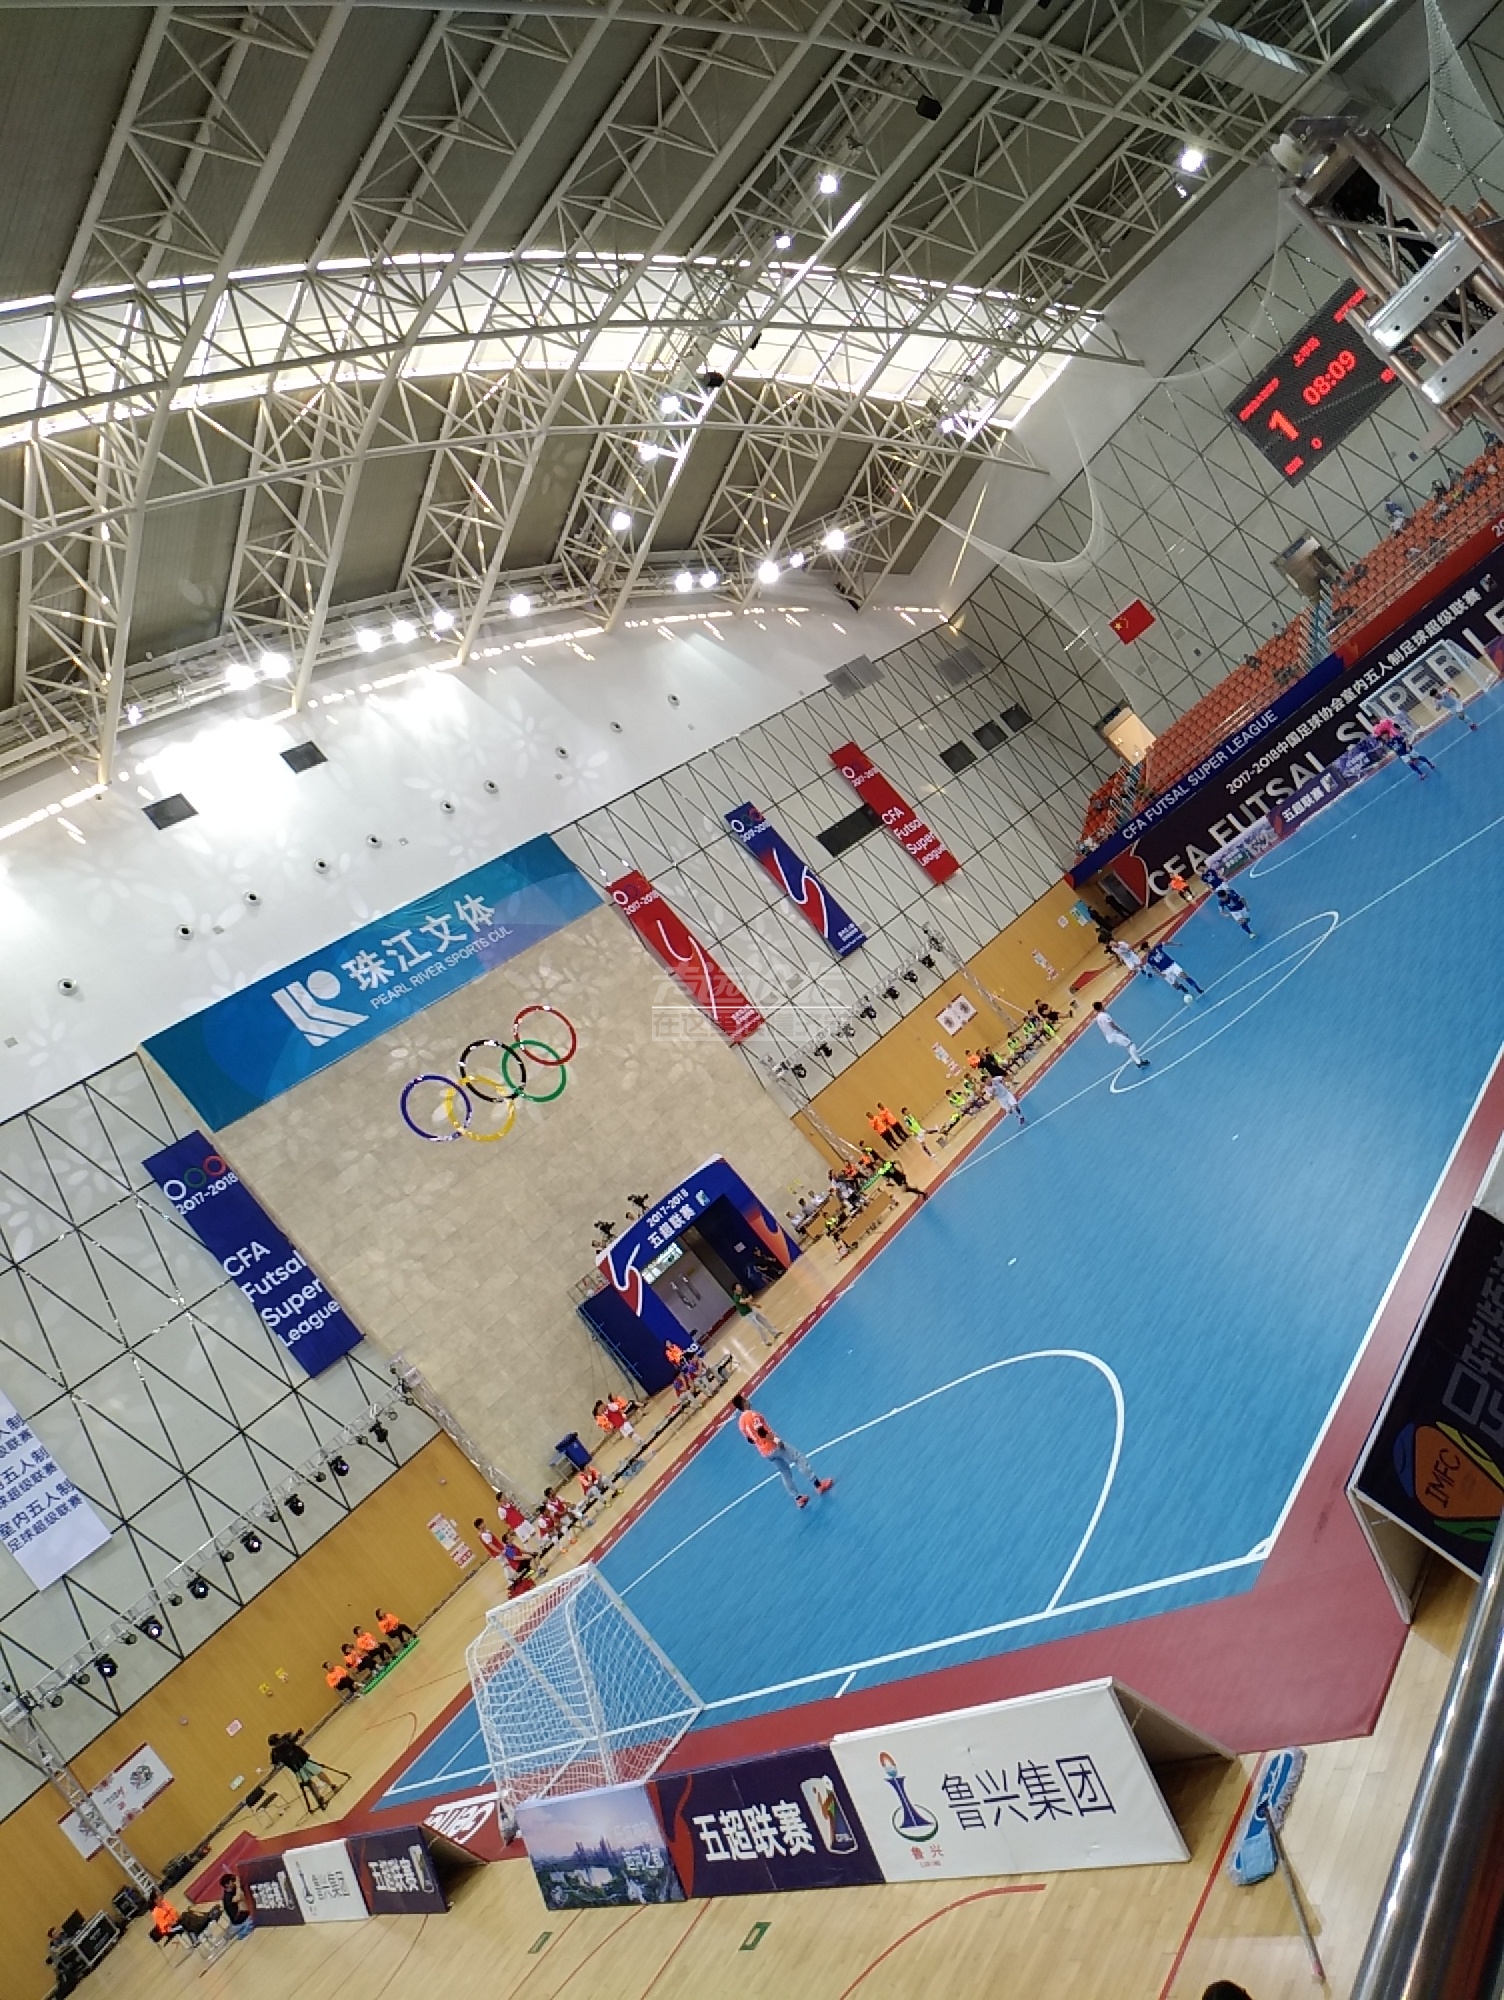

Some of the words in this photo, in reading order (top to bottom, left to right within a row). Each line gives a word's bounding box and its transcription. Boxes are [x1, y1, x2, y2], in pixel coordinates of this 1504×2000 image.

[1303, 350, 1356, 406] 08:09
[1122, 815, 1146, 840] CFA
[1145, 786, 1190, 823] FUTSAL
[1188, 750, 1227, 788] SUPER
[1227, 708, 1279, 757] LEAGUE
[881, 806, 905, 825] CFA
[1147, 843, 1209, 897] CFA
[341, 892, 495, 992] 珠江文体
[370, 983, 411, 1010] PEARL
[410, 961, 445, 989] RIVER
[445, 937, 489, 969] SPORTS
[488, 924, 513, 946] CUL
[175, 1171, 239, 1216] 2017-2018
[647, 1188, 690, 1227] 2017-2018
[647, 1203, 697, 1249] 五超联赛
[223, 1241, 270, 1277] CFA
[241, 1250, 307, 1303] Futsal
[261, 1278, 323, 1327] Super
[277, 1300, 340, 1348] League
[0, 1478, 77, 1541] 室内五人制
[7, 1494, 84, 1554] 足球超级联赛
[941, 1754, 1119, 1833] 鲁兴集团
[692, 1799, 815, 1863] 五超联赛
[368, 1856, 419, 1893] 五超联赛
